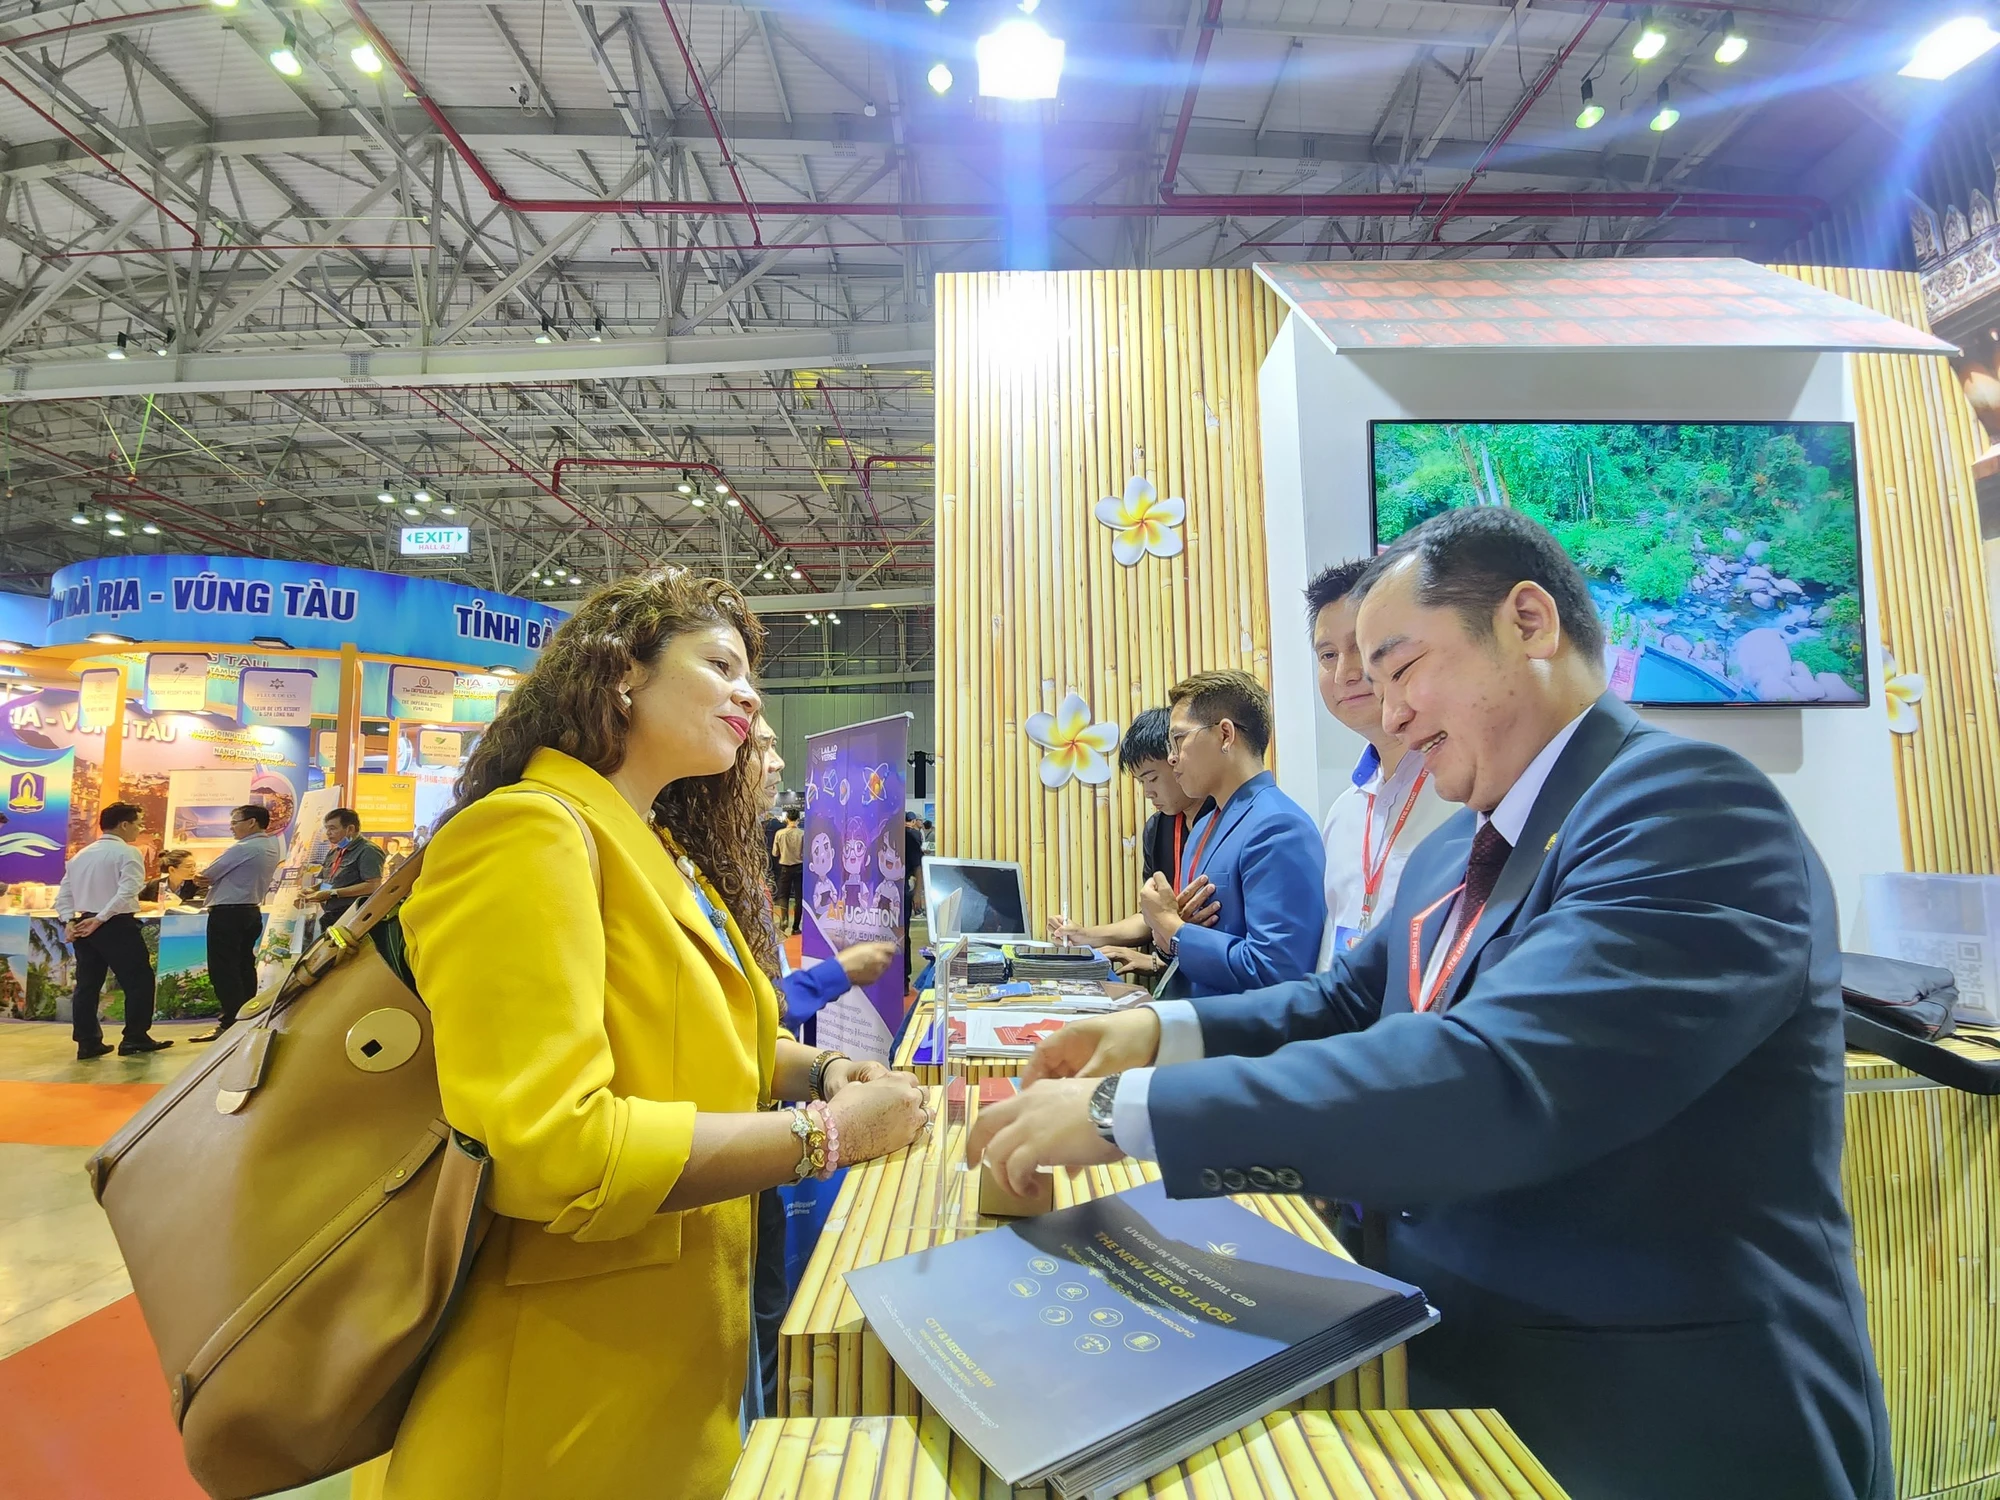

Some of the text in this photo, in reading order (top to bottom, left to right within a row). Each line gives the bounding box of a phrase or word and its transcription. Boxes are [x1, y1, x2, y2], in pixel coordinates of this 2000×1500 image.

[414, 531, 454, 544] EXIT
[66, 577, 90, 617] BÀ
[96, 579, 140, 619] RỊA
[173, 573, 270, 614] VŨNG
[283, 579, 356, 621] TÀU
[455, 600, 520, 645] TỈNH
[132, 717, 178, 743] TÀU
[1399, 791, 1417, 821] ITE HCMC
[1446, 954, 1458, 971] ITE
[1094, 1231, 1238, 1325] THE NEW LIFE OF LAOS!
[1123, 1226, 1158, 1250] LIVING
[1155, 1247, 1170, 1259] IN
[1168, 1254, 1189, 1272] THE
[1187, 1268, 1231, 1296] CAPITAL
[1230, 1293, 1257, 1308] CBD
[1152, 1261, 1189, 1285] LEADING
[925, 1317, 996, 1388] CITY & MEKONG VIEW
